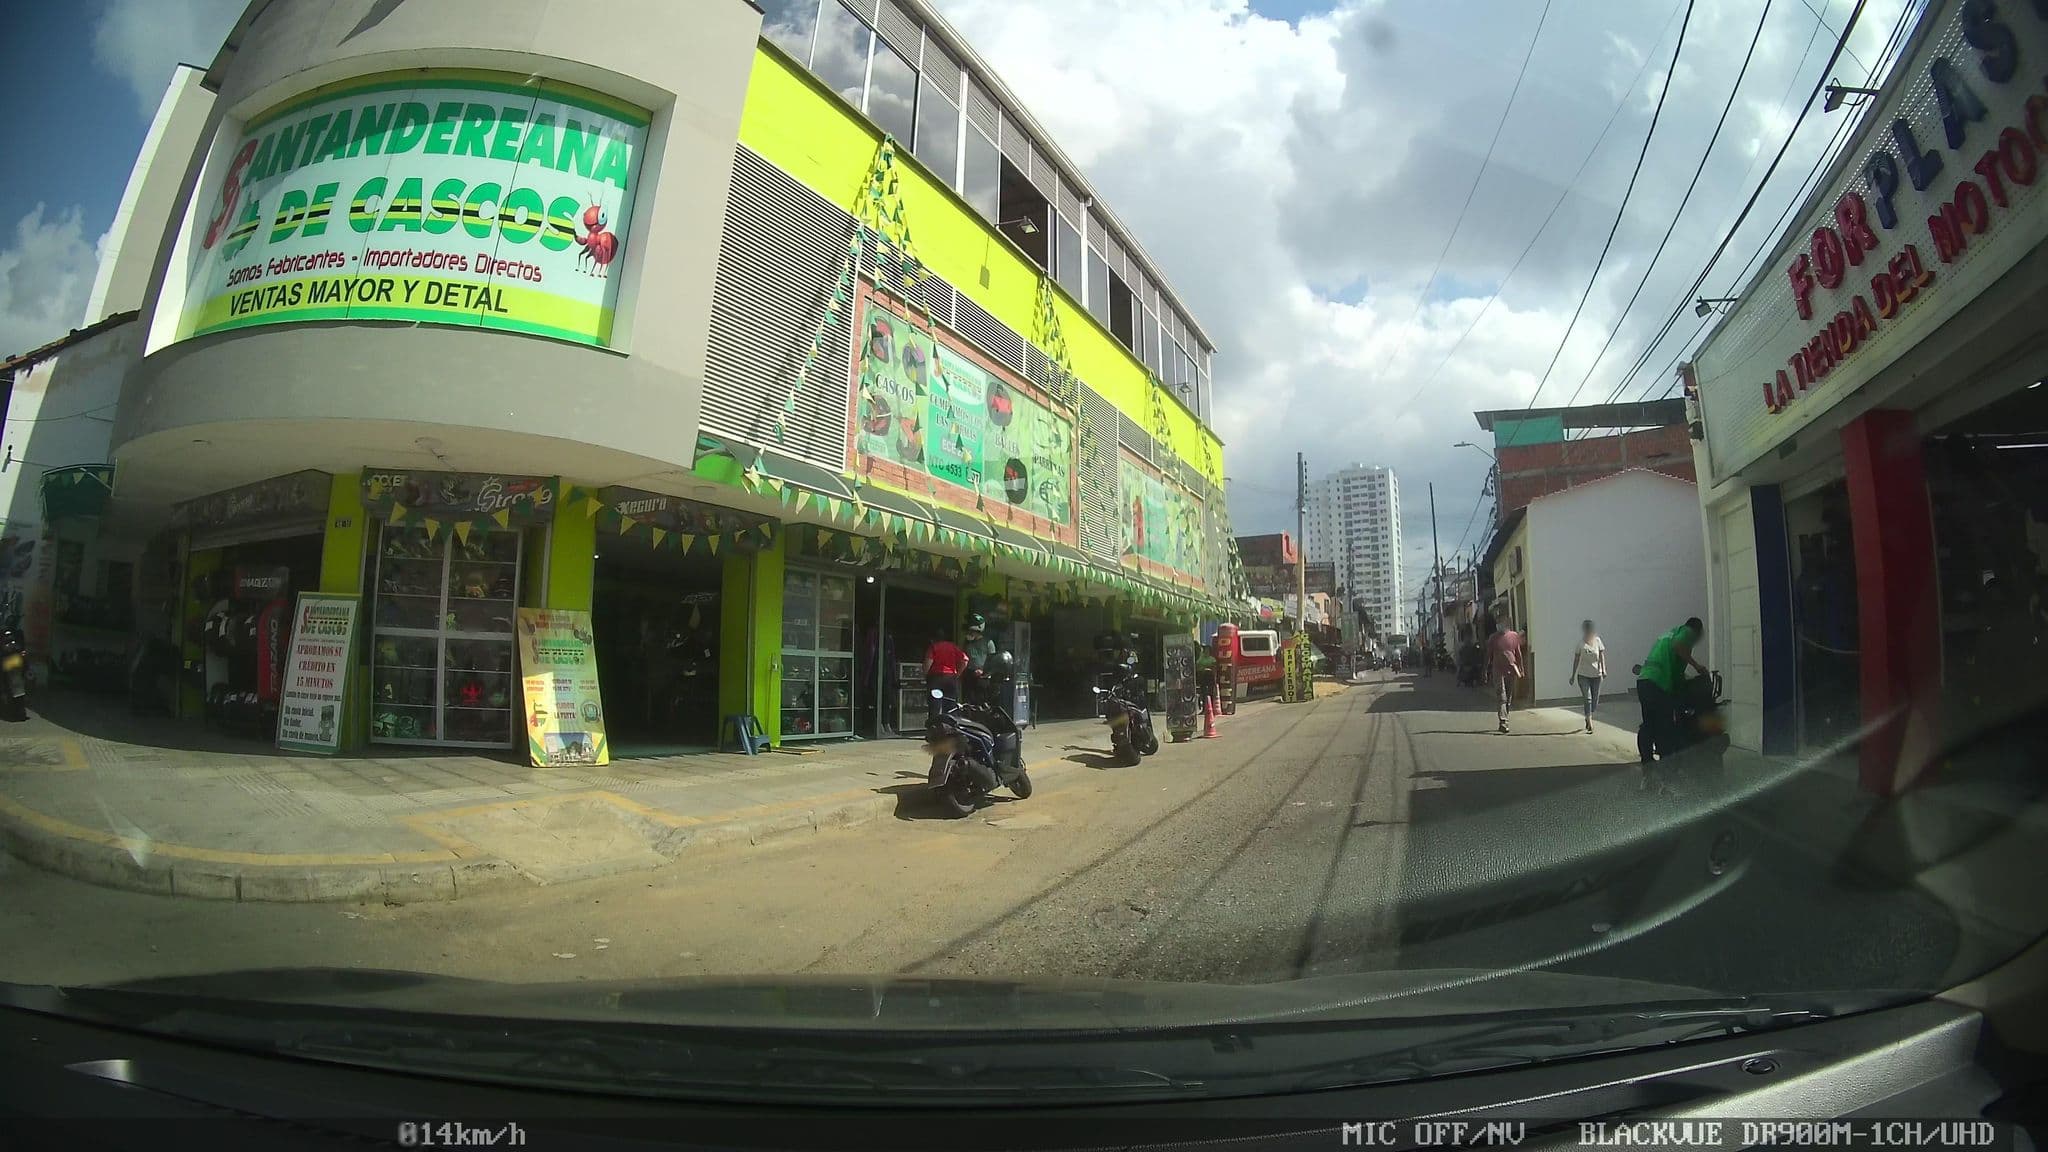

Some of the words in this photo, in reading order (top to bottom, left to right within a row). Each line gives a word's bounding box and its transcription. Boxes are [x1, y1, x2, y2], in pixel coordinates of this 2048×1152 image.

[203, 102, 629, 249] SANTANDEREANA
[1788, 0, 2048, 320] FORPLAS
[269, 182, 340, 244] DE
[348, 177, 581, 251] CASCOS
[226, 262, 263, 288] Somos
[266, 250, 345, 277] Fabricantes
[363, 248, 468, 271] Importadores
[475, 253, 542, 283] Directos
[231, 281, 303, 316] VENTAS
[308, 278, 394, 304] MAYOR
[403, 279, 419, 303] Y
[424, 281, 508, 313] DETAL
[1763, 369, 1795, 414] LA
[1787, 295, 1878, 390] TIENDA
[1871, 244, 1936, 320] DEL
[875, 374, 914, 405] CASCOS
